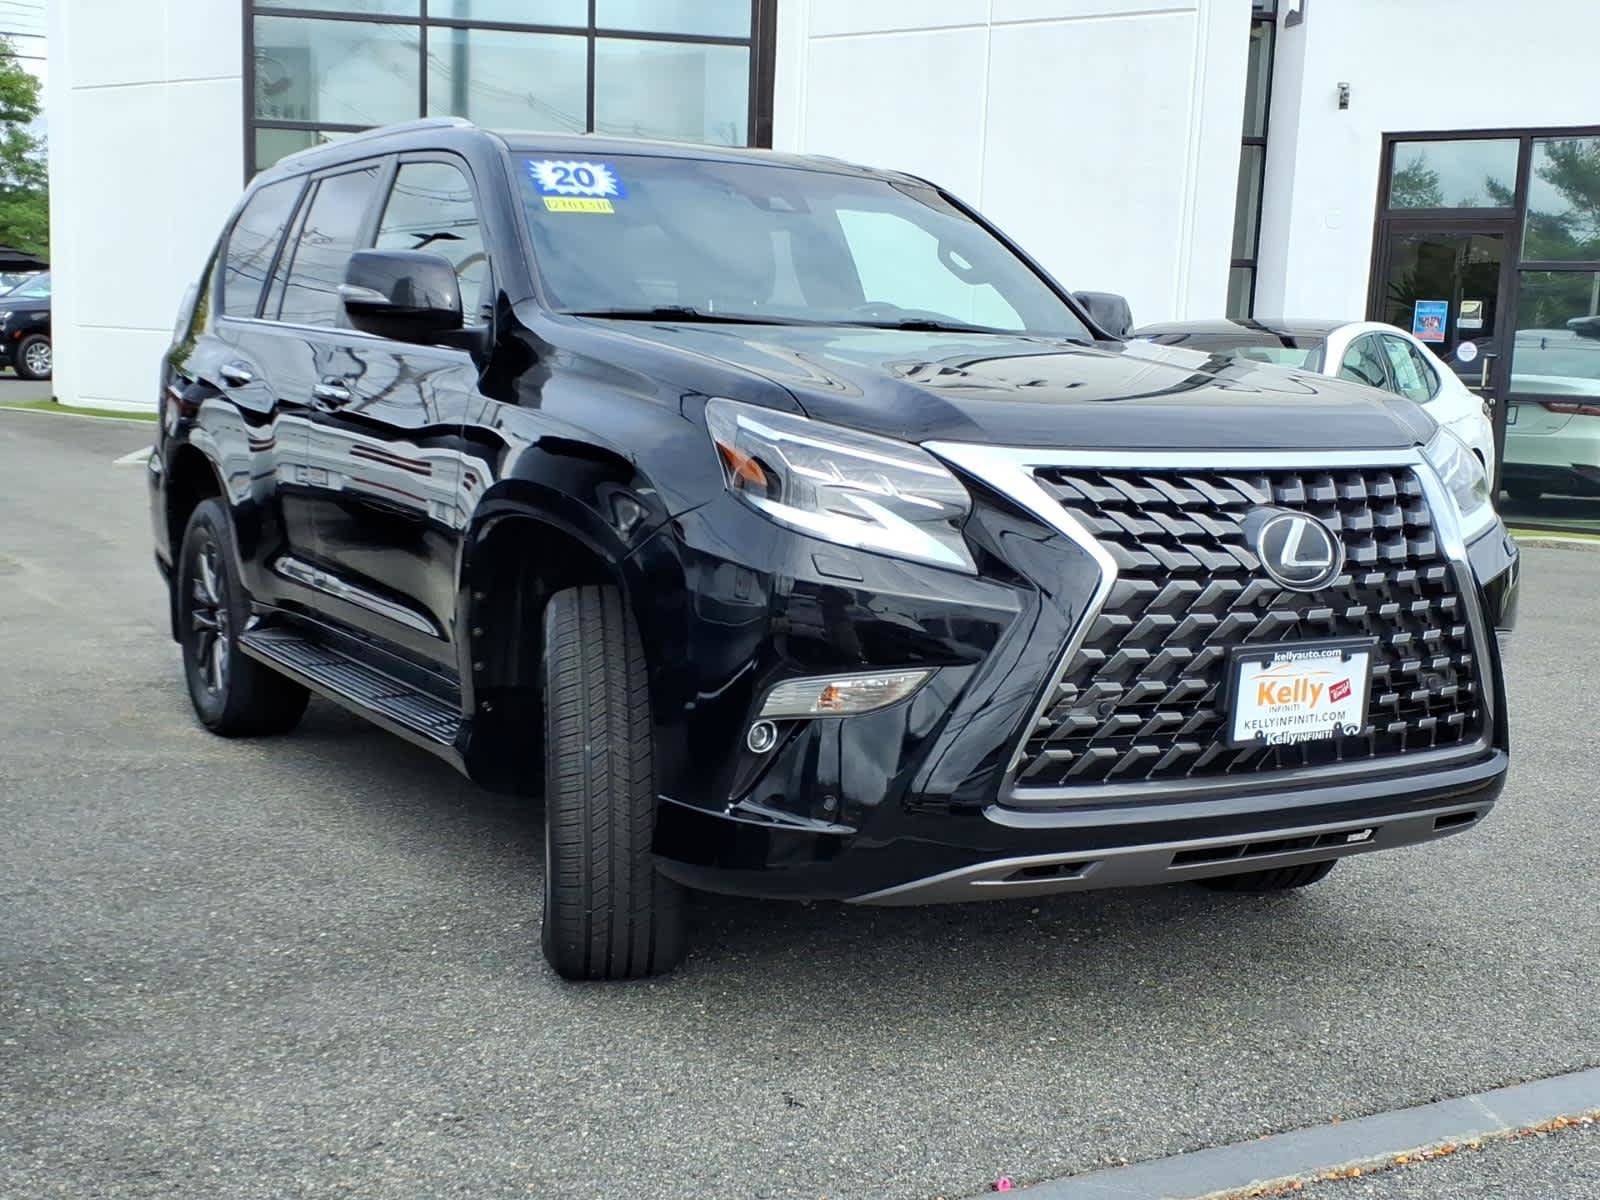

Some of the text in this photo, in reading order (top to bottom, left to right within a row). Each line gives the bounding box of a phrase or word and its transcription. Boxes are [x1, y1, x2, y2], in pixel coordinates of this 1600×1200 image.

[551, 167, 595, 188] 20
[1274, 649, 1342, 663] kellyauto.com
[1257, 678, 1324, 711] Kelly
[1268, 703, 1300, 714] INFINITI
[1244, 711, 1346, 730] KELLYINFINITI.COM
